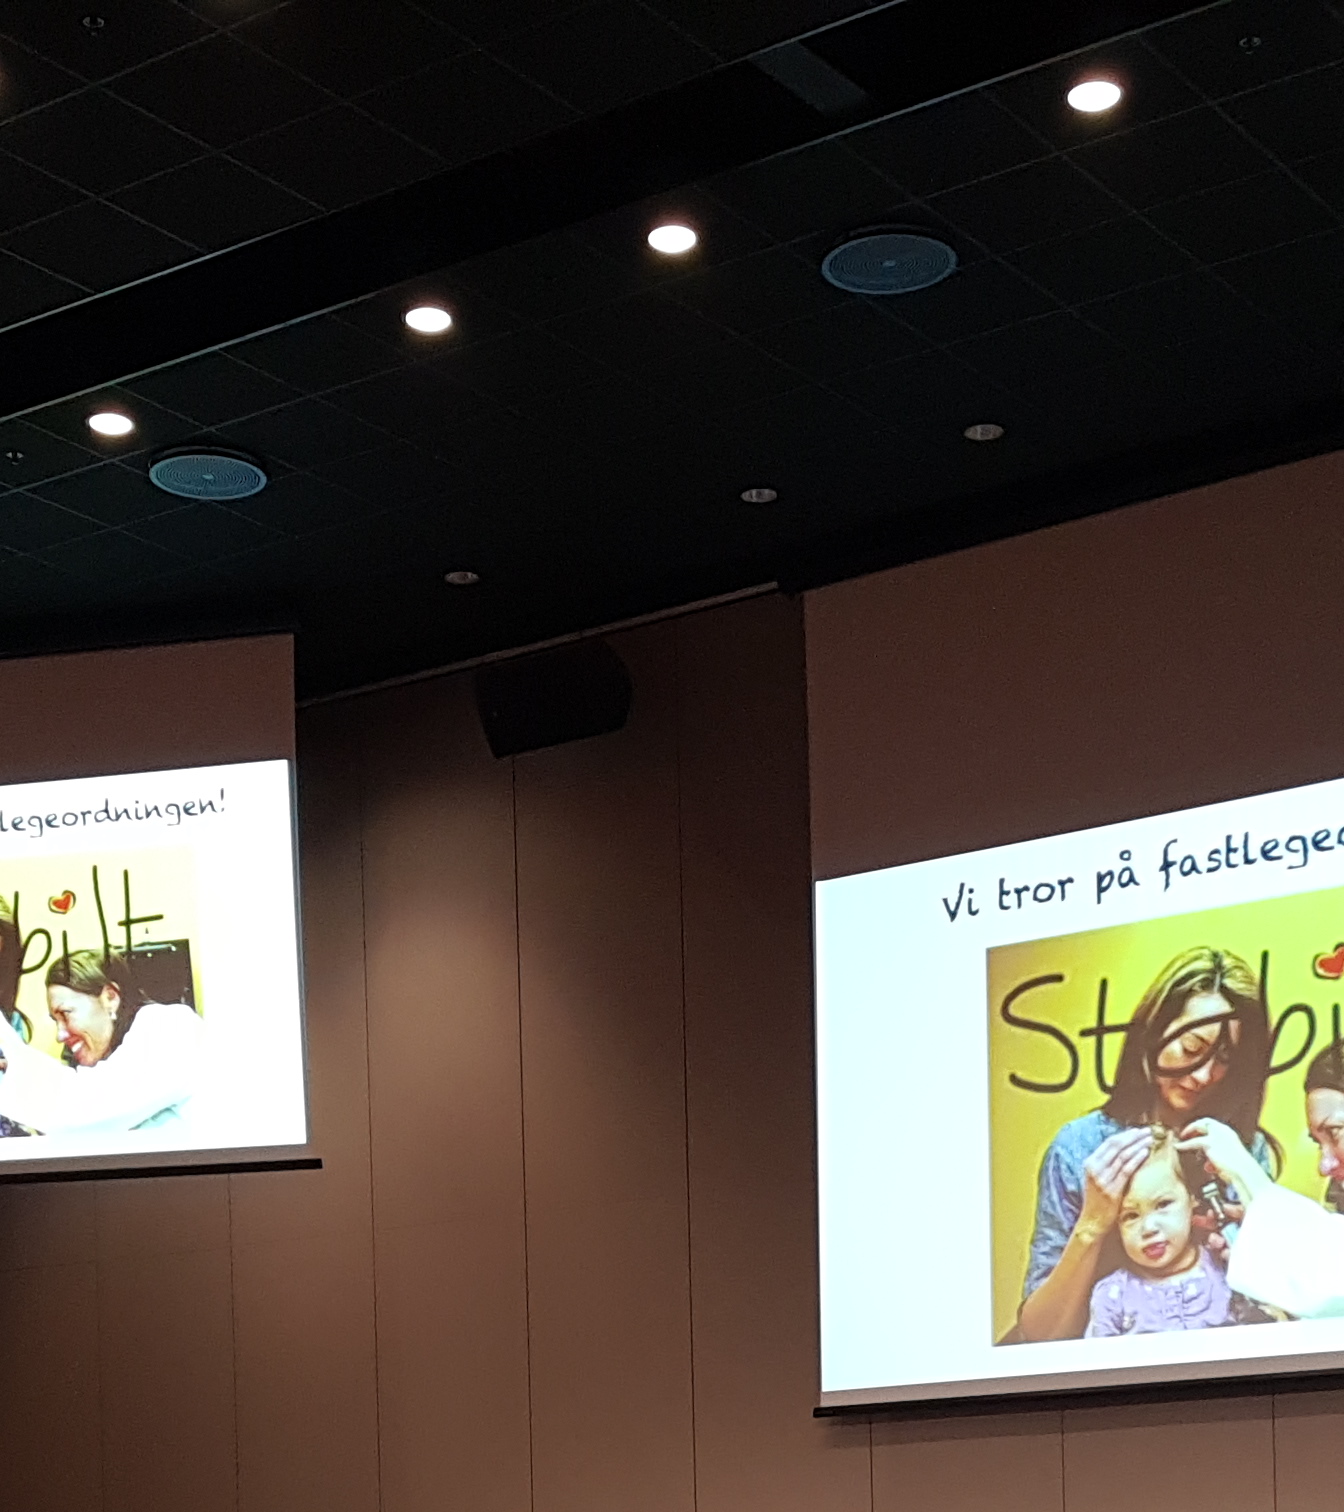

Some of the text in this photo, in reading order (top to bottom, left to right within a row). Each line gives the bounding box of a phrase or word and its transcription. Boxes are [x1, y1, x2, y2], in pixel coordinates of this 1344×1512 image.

[942, 882, 980, 923] Vi
[998, 877, 1075, 911] tror
[1095, 849, 1141, 905] på
